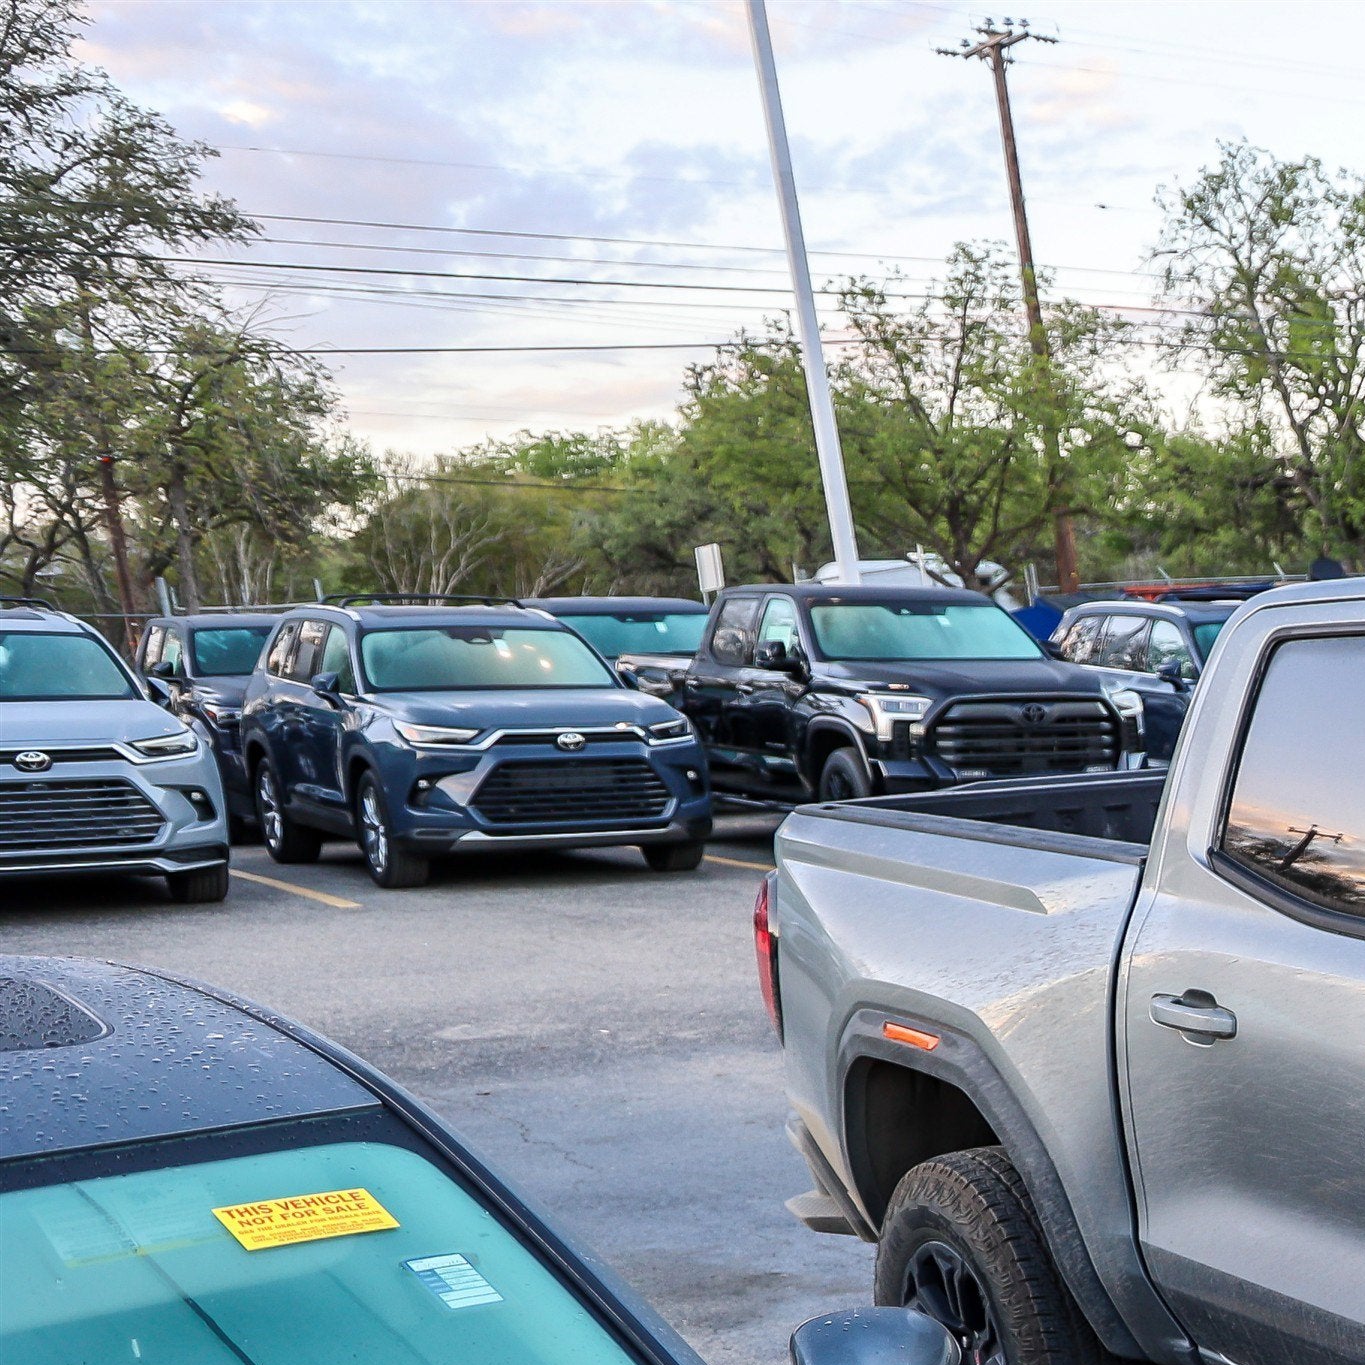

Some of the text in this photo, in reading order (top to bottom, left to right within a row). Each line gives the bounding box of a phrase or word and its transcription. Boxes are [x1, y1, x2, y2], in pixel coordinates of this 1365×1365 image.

[221, 1191, 366, 1219] THIS VEHICLE
[237, 1202, 370, 1228] NOT FOR SALE
